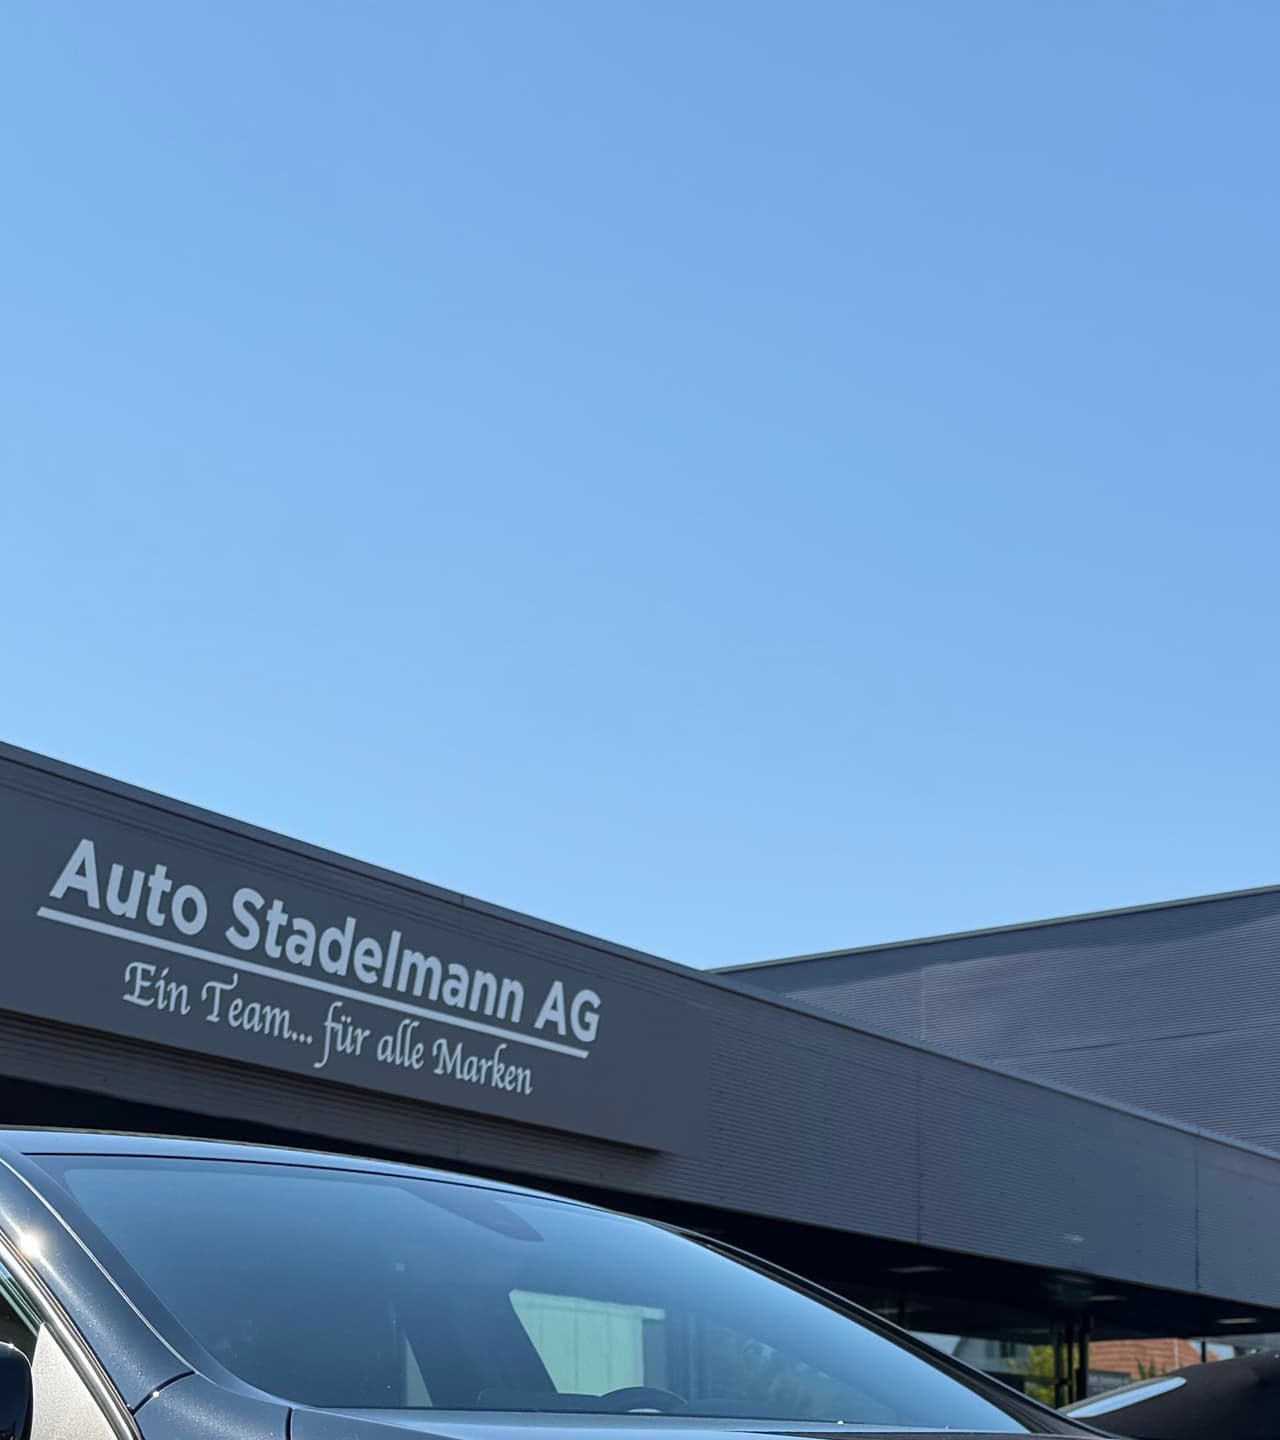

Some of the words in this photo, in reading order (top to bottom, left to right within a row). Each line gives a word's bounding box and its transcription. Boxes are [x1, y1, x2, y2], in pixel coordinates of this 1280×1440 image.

[48, 838, 208, 936] Auto
[224, 887, 525, 1024] Stadelmann
[533, 980, 602, 1043] AG
[122, 960, 191, 1016] Ein
[200, 972, 314, 1045] Team...
[313, 1001, 371, 1069] für
[376, 1018, 425, 1070] alle
[432, 1037, 534, 1096] Marken
